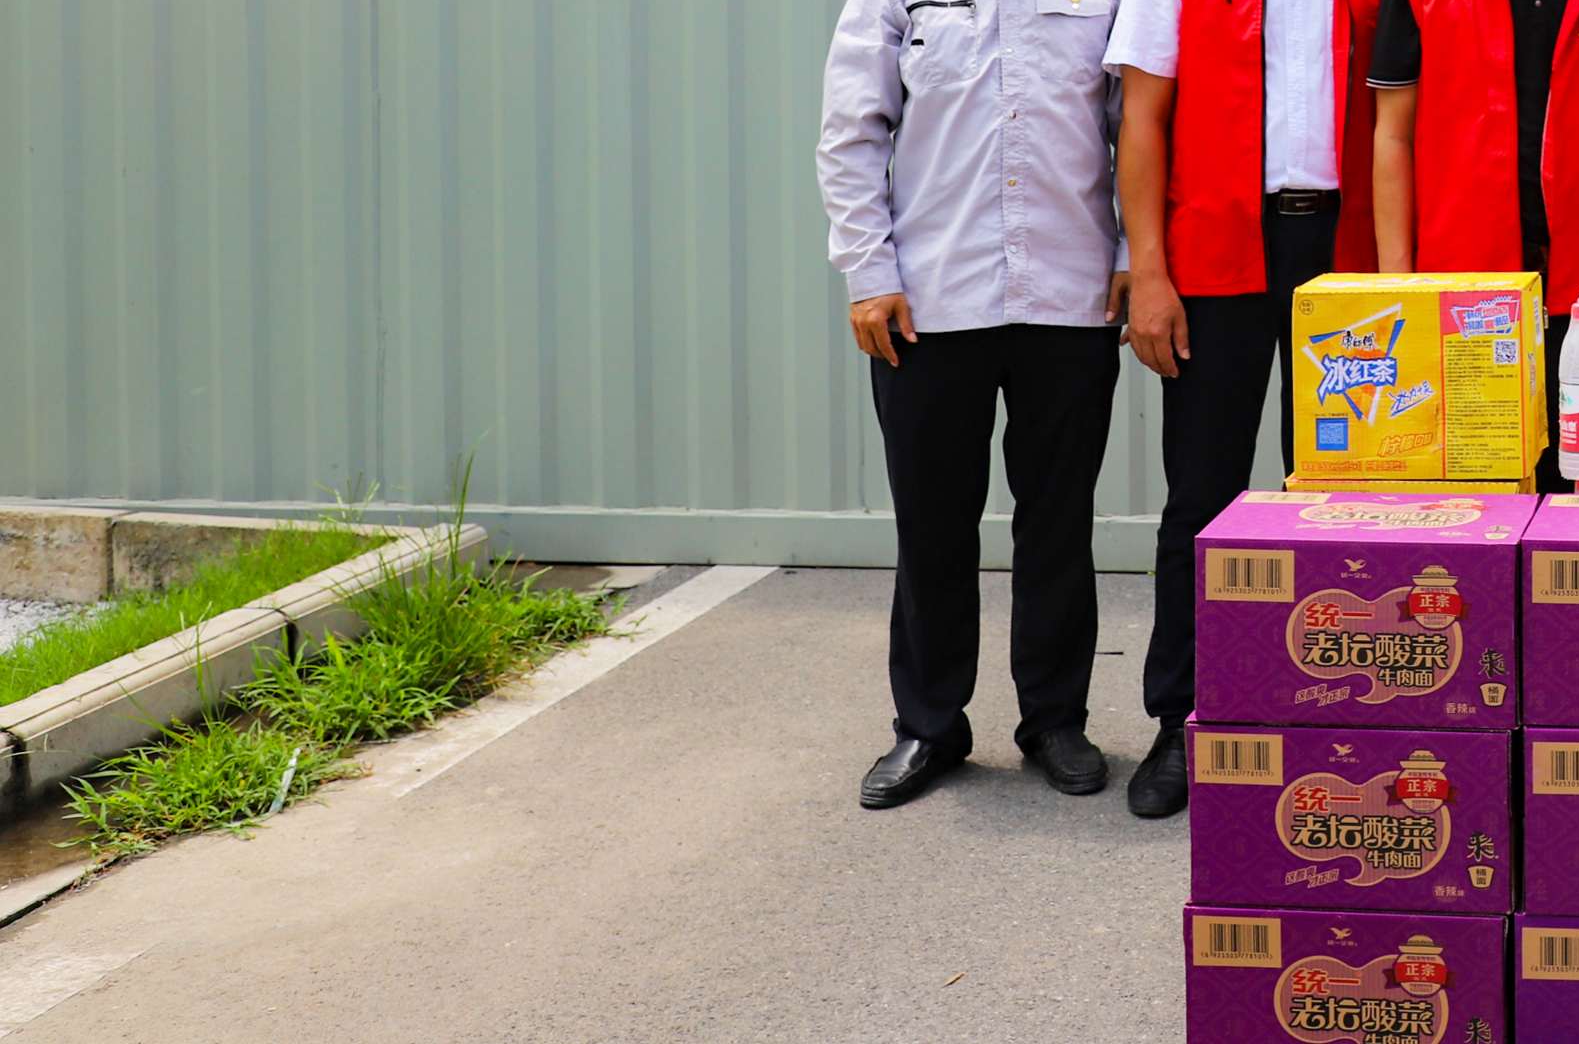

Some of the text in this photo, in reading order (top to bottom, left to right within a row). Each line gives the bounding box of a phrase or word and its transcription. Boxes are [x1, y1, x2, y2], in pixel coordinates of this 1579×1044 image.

[1318, 355, 1397, 404] 冰红茶
[1419, 594, 1451, 607] 正宗
[1304, 603, 1375, 629] 统一
[1304, 633, 1448, 669] 老坛酸菜
[1378, 669, 1434, 687] 牛肉面
[1407, 779, 1437, 792] 正宗
[1294, 786, 1361, 813] 统一
[1291, 815, 1436, 851] 老坛酸菜
[1367, 851, 1422, 869] 牛肉面
[1292, 968, 1360, 995] 统一
[1405, 964, 1436, 976] 正宗
[1289, 997, 1434, 1035] 老坛酸菜
